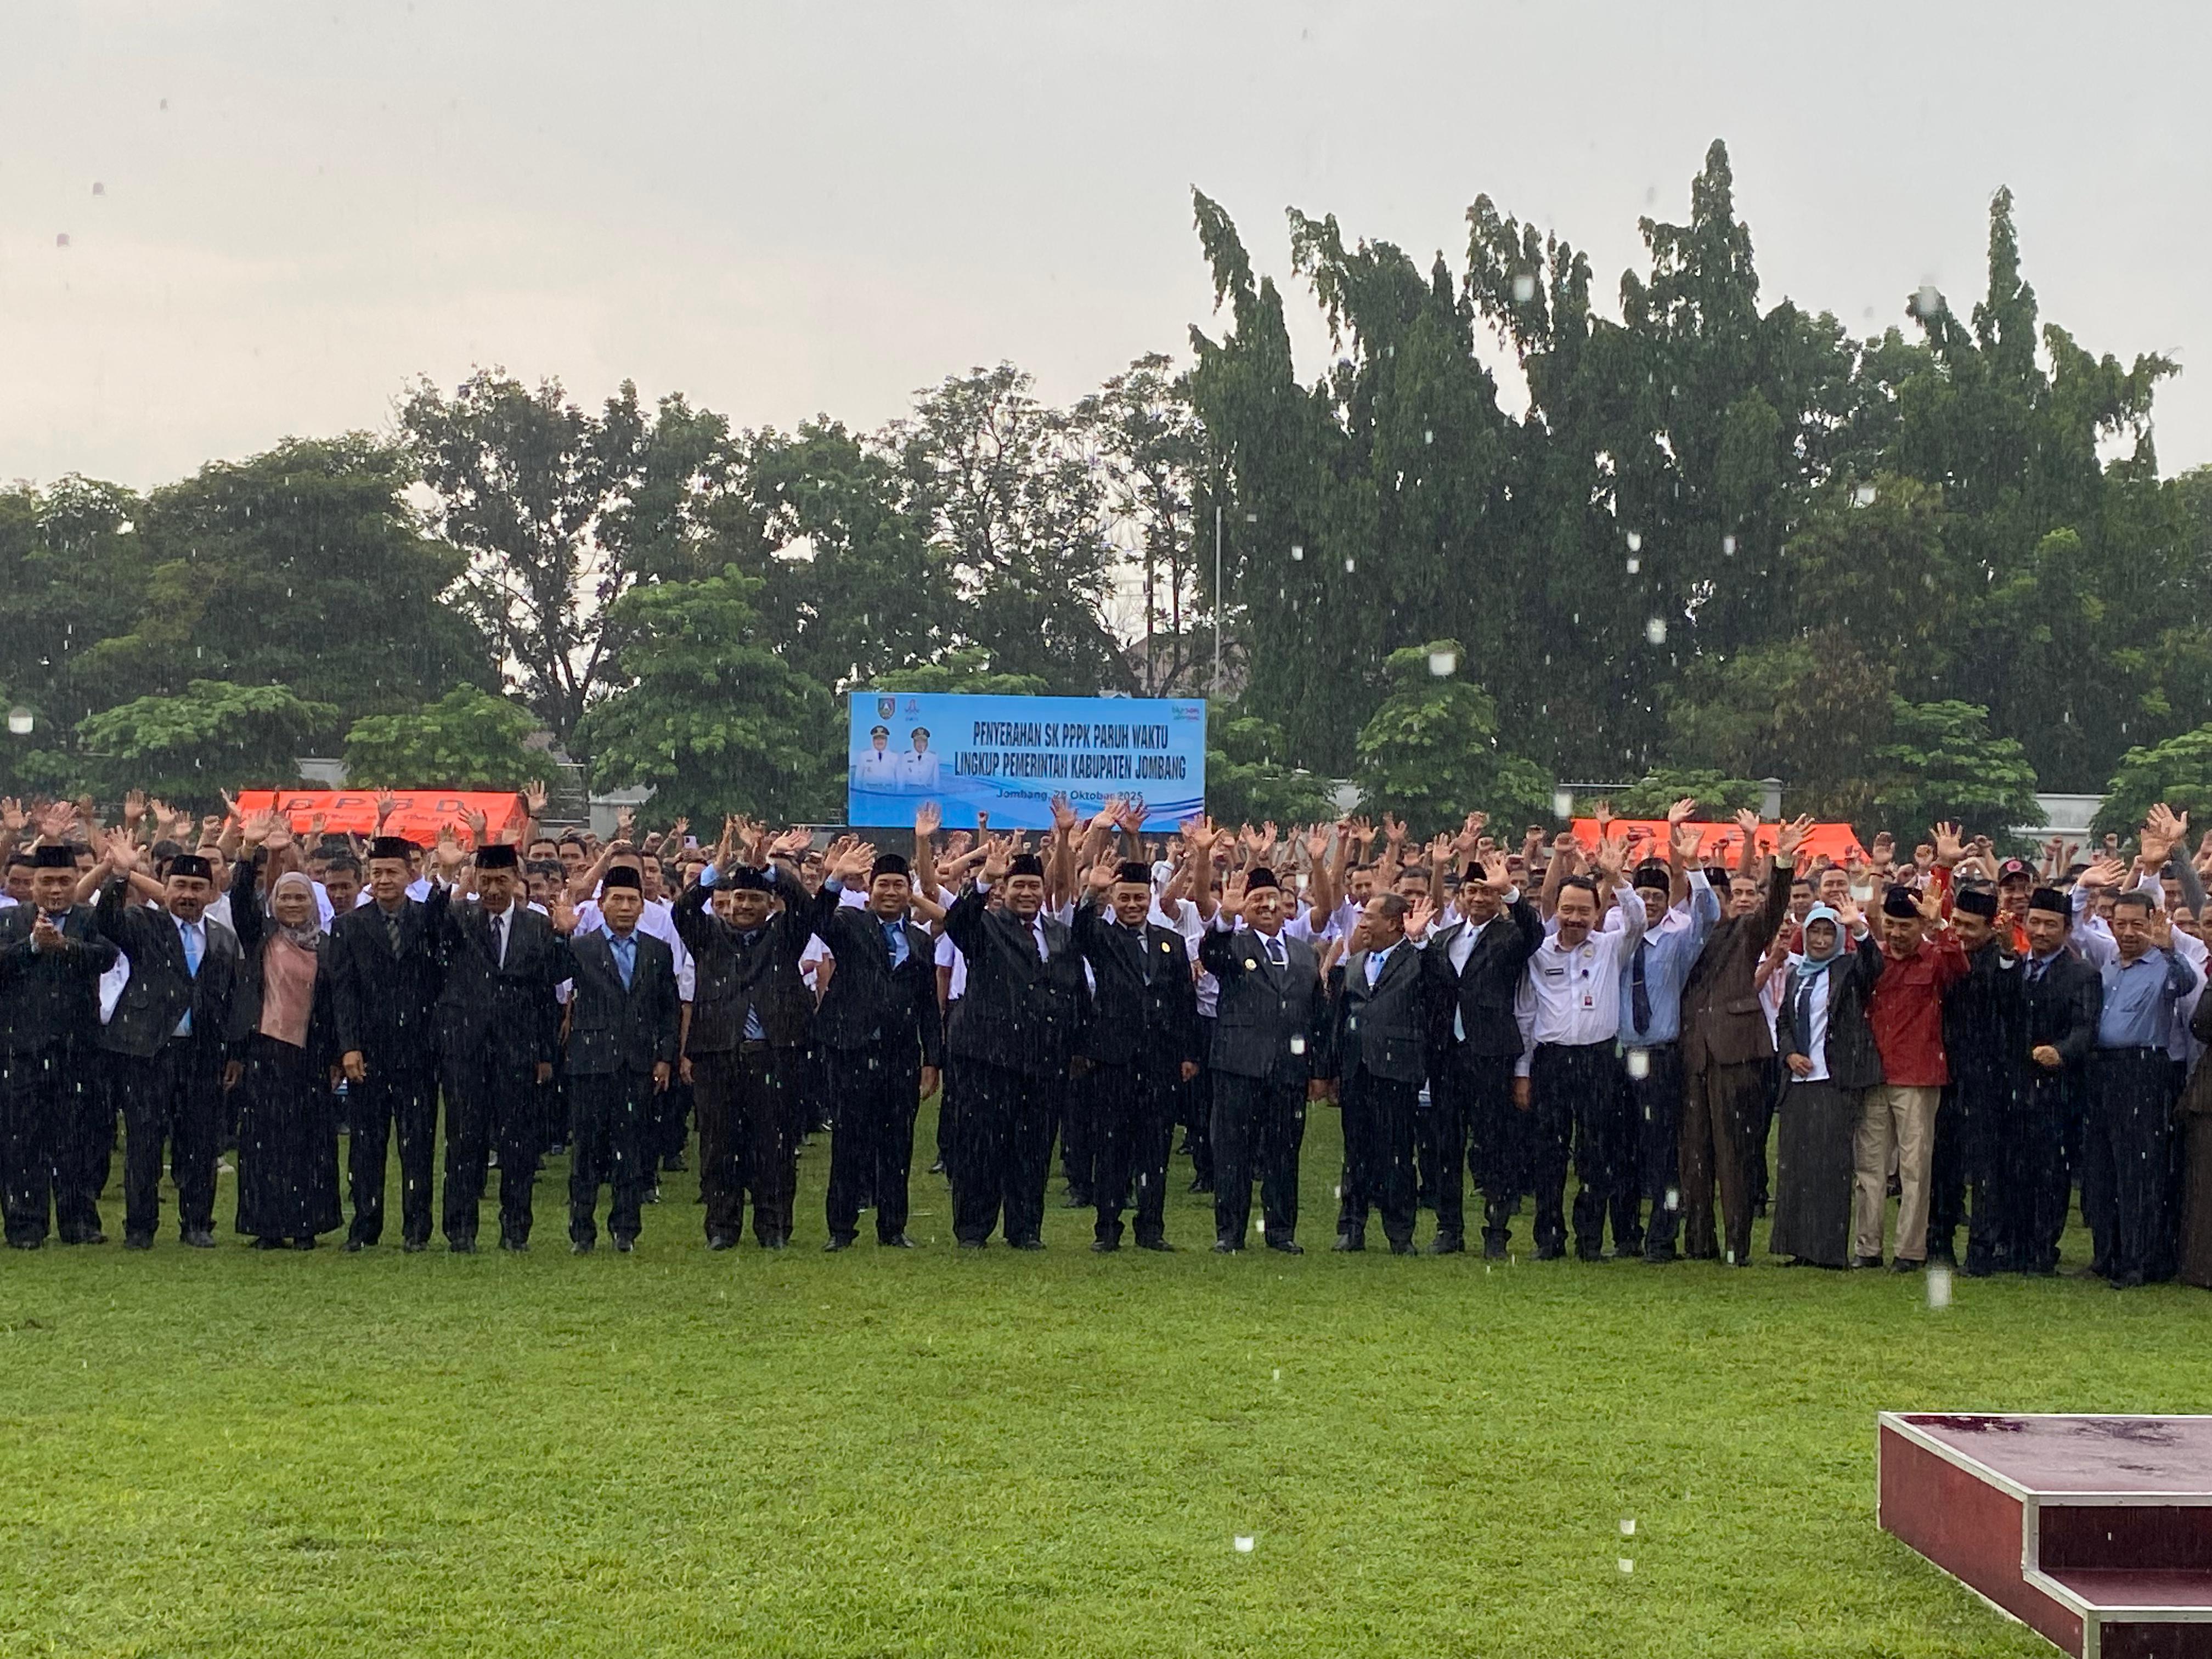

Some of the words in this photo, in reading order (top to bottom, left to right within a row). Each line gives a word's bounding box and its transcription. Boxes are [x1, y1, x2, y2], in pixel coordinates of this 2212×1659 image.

[973, 721, 1042, 747] PENYERAHAN
[1045, 723, 1059, 748] SK
[1062, 723, 1091, 748] PPPK
[1093, 724, 1129, 749] PARUH
[1132, 724, 1169, 749] WAKTU
[955, 751, 1000, 776] LINGKUP
[1002, 752, 1068, 778] PEMERINTAH
[1071, 754, 1132, 780] KABUPATEN
[1135, 754, 1187, 780] JOMBANG
